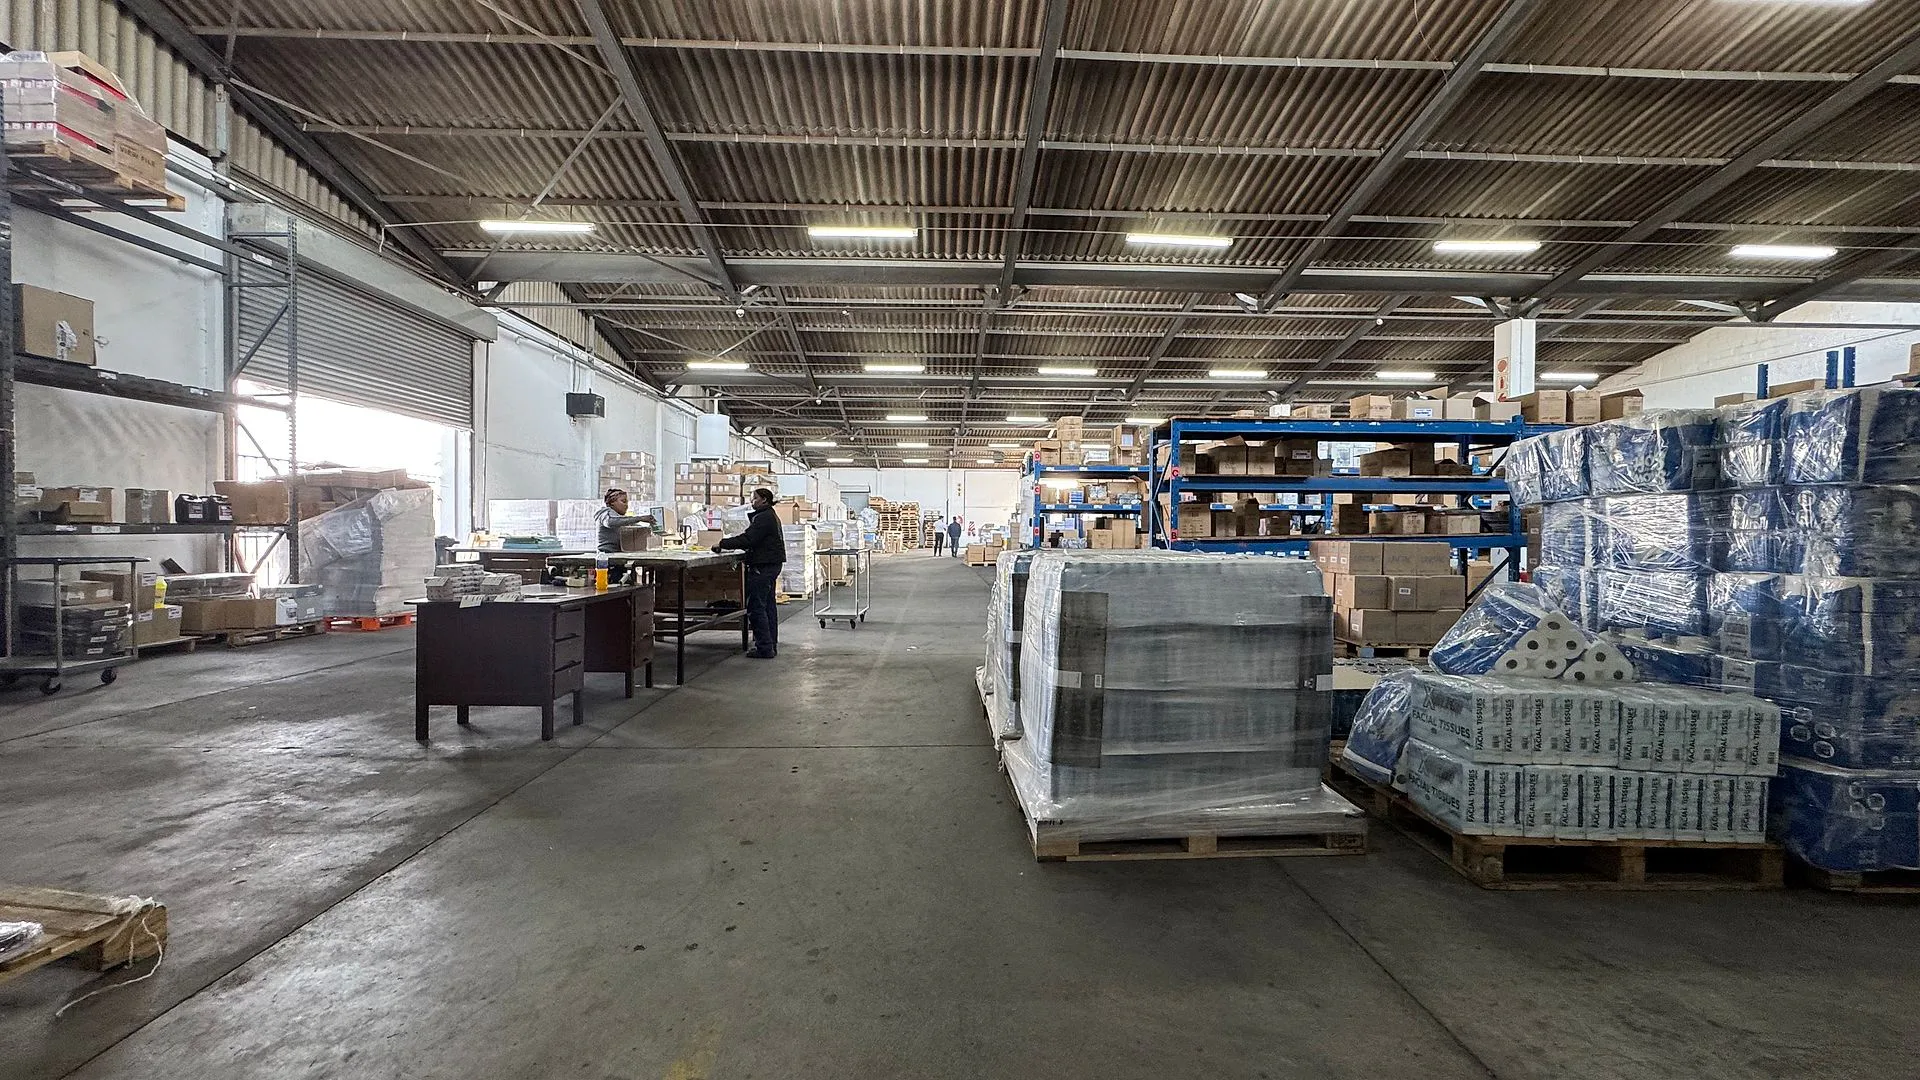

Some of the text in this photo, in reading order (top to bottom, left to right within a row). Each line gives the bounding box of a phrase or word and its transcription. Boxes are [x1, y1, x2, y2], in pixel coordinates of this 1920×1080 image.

[1172, 469, 1179, 477] C
[1171, 531, 1178, 540] B
[1412, 709, 1471, 739] FACIAL TISSUES
[1476, 697, 1484, 750] FACIAL TISSUES
[1564, 698, 1572, 726] TISSUES
[1594, 699, 1602, 727] TISSUES
[1658, 709, 1666, 737] TISSUES
[1625, 707, 1634, 760] FACIAL TISSUES
[1688, 709, 1697, 763] FACIAL TISSUES
[1751, 712, 1761, 766] FACIAL TISSUES
[1467, 769, 1475, 822] FACIAL TISSUES
[1593, 775, 1601, 803] TISSUES
